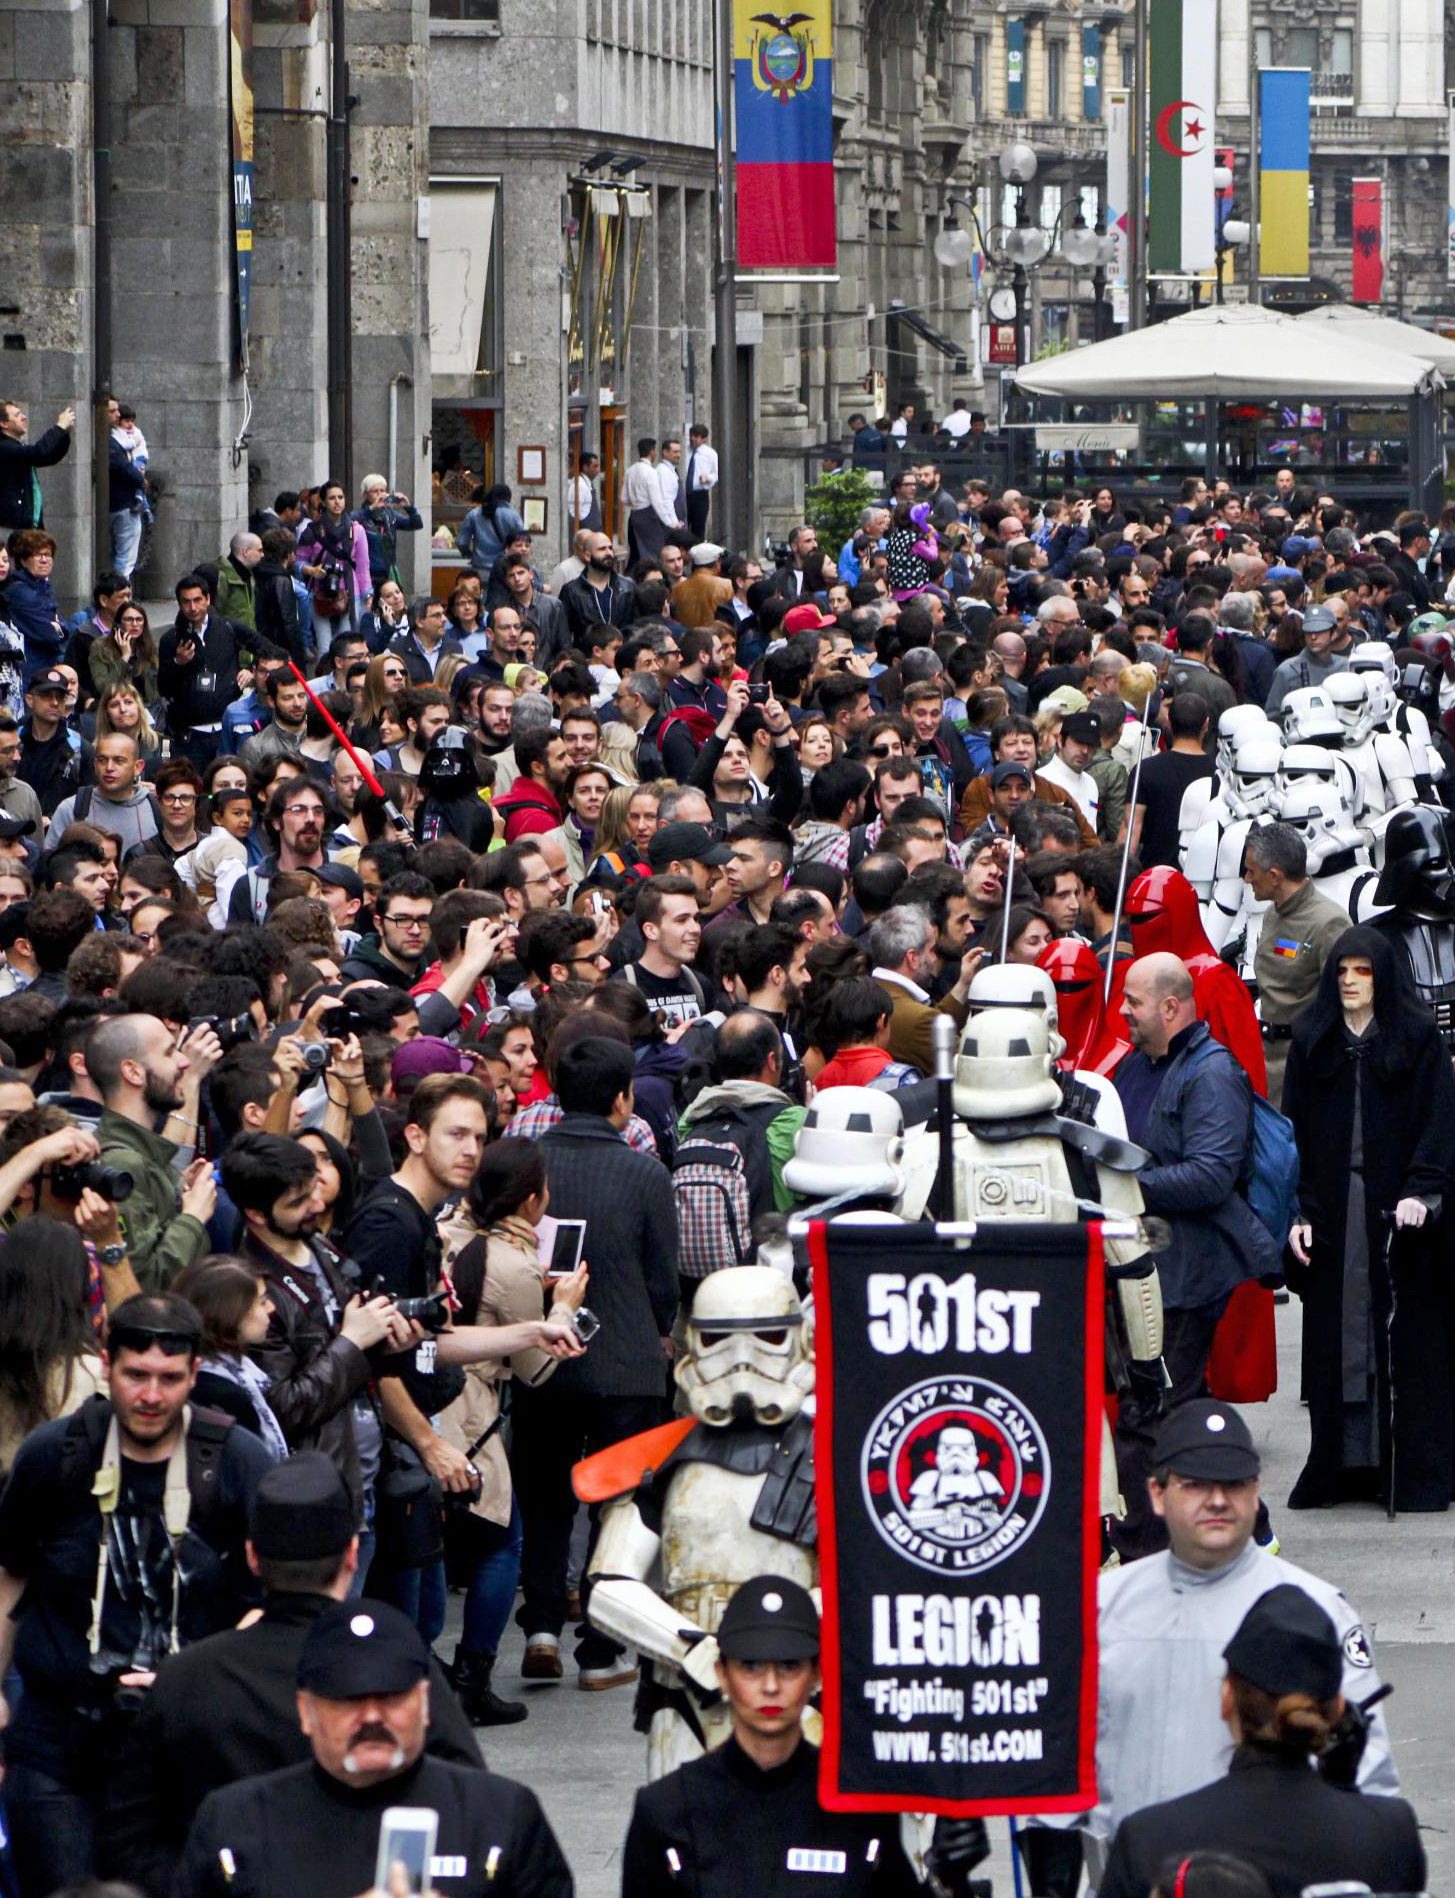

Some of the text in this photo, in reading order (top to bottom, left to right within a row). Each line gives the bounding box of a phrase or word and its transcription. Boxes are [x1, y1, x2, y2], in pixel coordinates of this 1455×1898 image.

[867, 1272, 1041, 1355] 501ST
[882, 1511, 1027, 1567] 501ST LEGION
[872, 1593, 1041, 1668] LEGION
